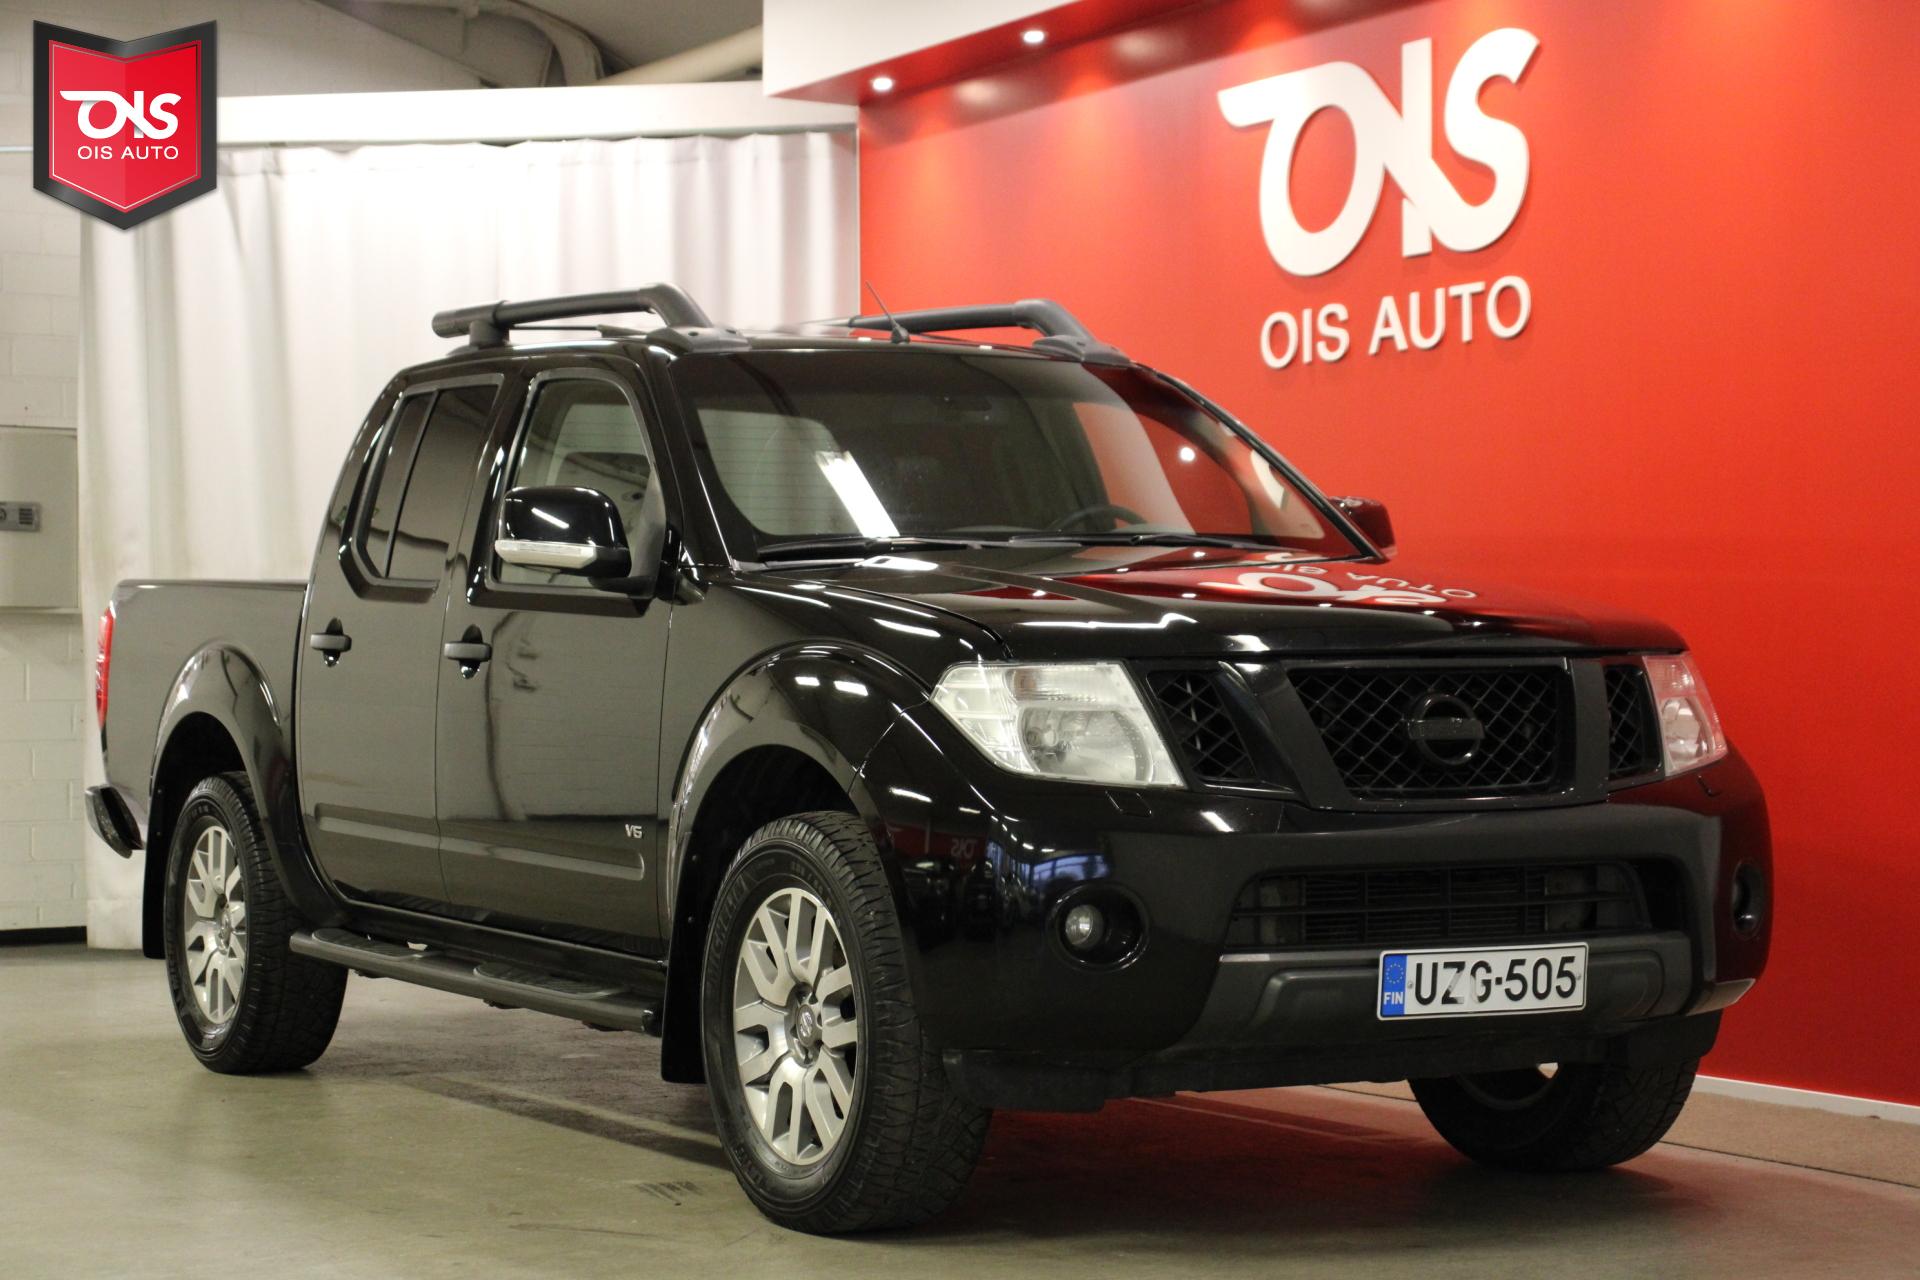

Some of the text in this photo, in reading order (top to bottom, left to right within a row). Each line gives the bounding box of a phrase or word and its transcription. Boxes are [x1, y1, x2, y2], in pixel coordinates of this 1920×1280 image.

[1217, 27, 1540, 276] OIS
[1260, 275, 1532, 369] OIS AUTO
[625, 823, 643, 839] V6
[1384, 991, 1404, 1006] FIN
[1415, 956, 1577, 1006] UZG-505
